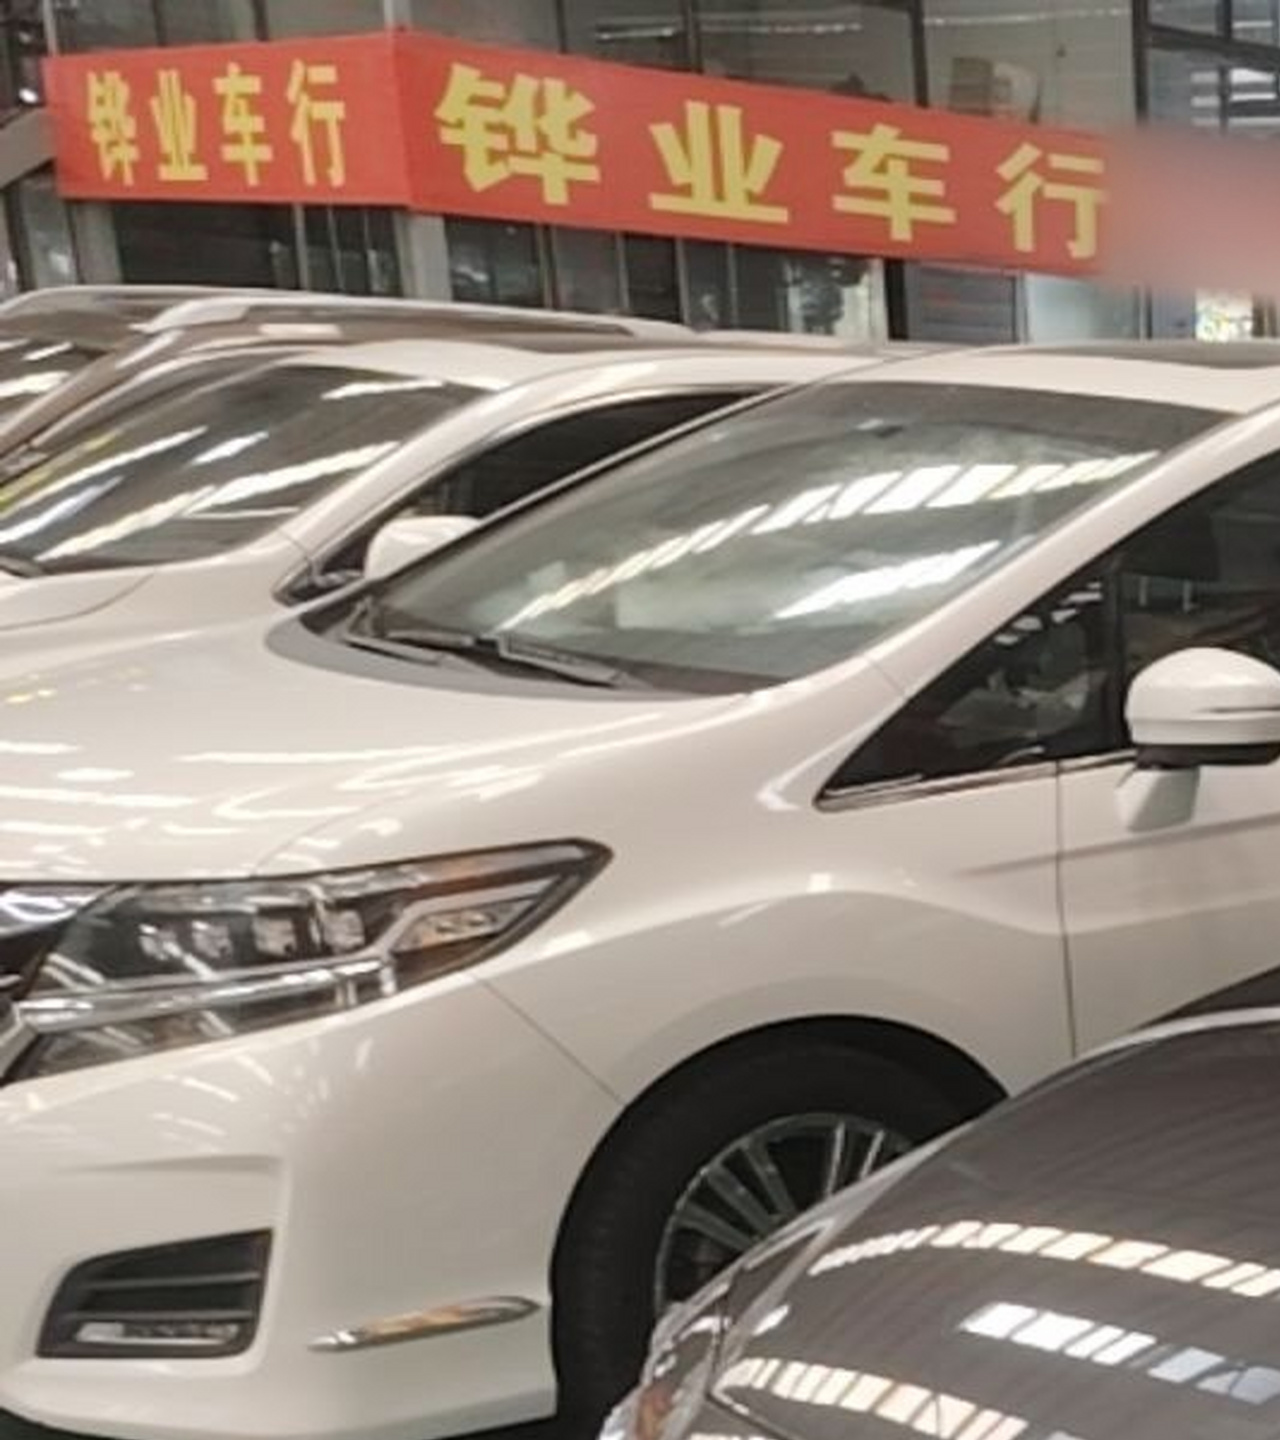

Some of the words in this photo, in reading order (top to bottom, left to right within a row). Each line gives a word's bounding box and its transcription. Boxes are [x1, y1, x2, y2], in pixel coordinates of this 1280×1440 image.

[87, 59, 346, 188] 铧业车行
[433, 62, 1105, 260] 铧业车行
